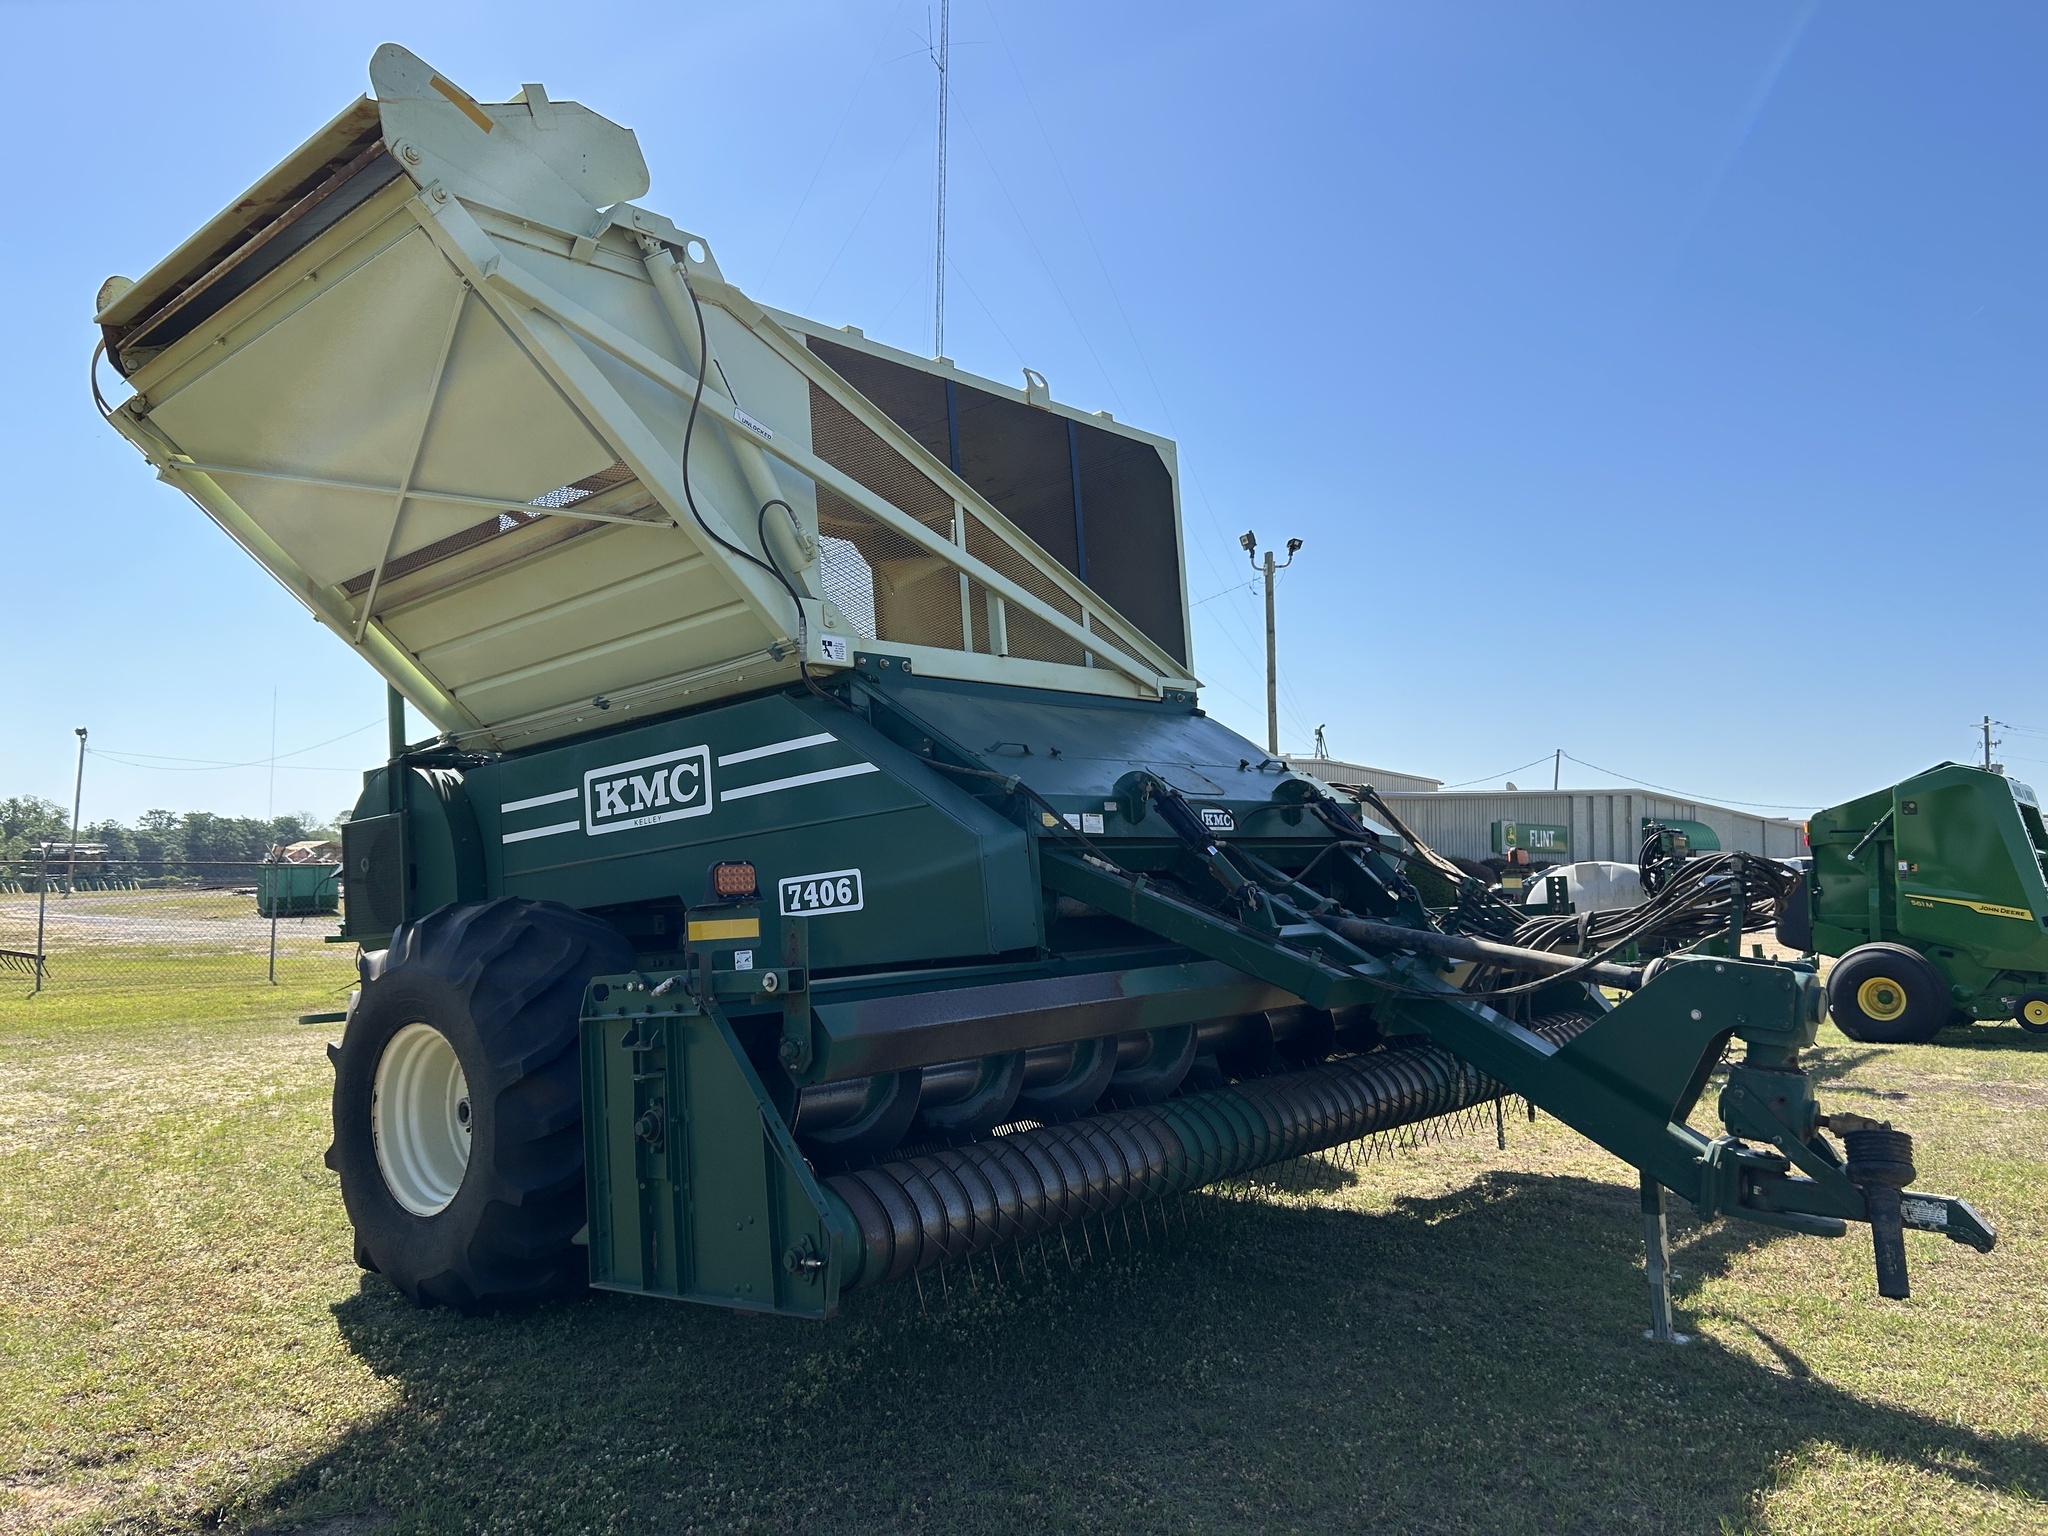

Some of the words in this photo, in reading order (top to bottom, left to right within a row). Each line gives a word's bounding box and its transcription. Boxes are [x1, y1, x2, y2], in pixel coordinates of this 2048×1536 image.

[741, 417, 772, 440] UNLOCKED
[595, 763, 699, 818] KMC
[633, 815, 662, 826] KELLEY
[1204, 813, 1231, 827] KMC
[1529, 830, 1555, 847] FLINT
[787, 877, 853, 911] 7406
[1979, 905, 1999, 913] JOHN
[2000, 907, 2025, 916] DEERE
